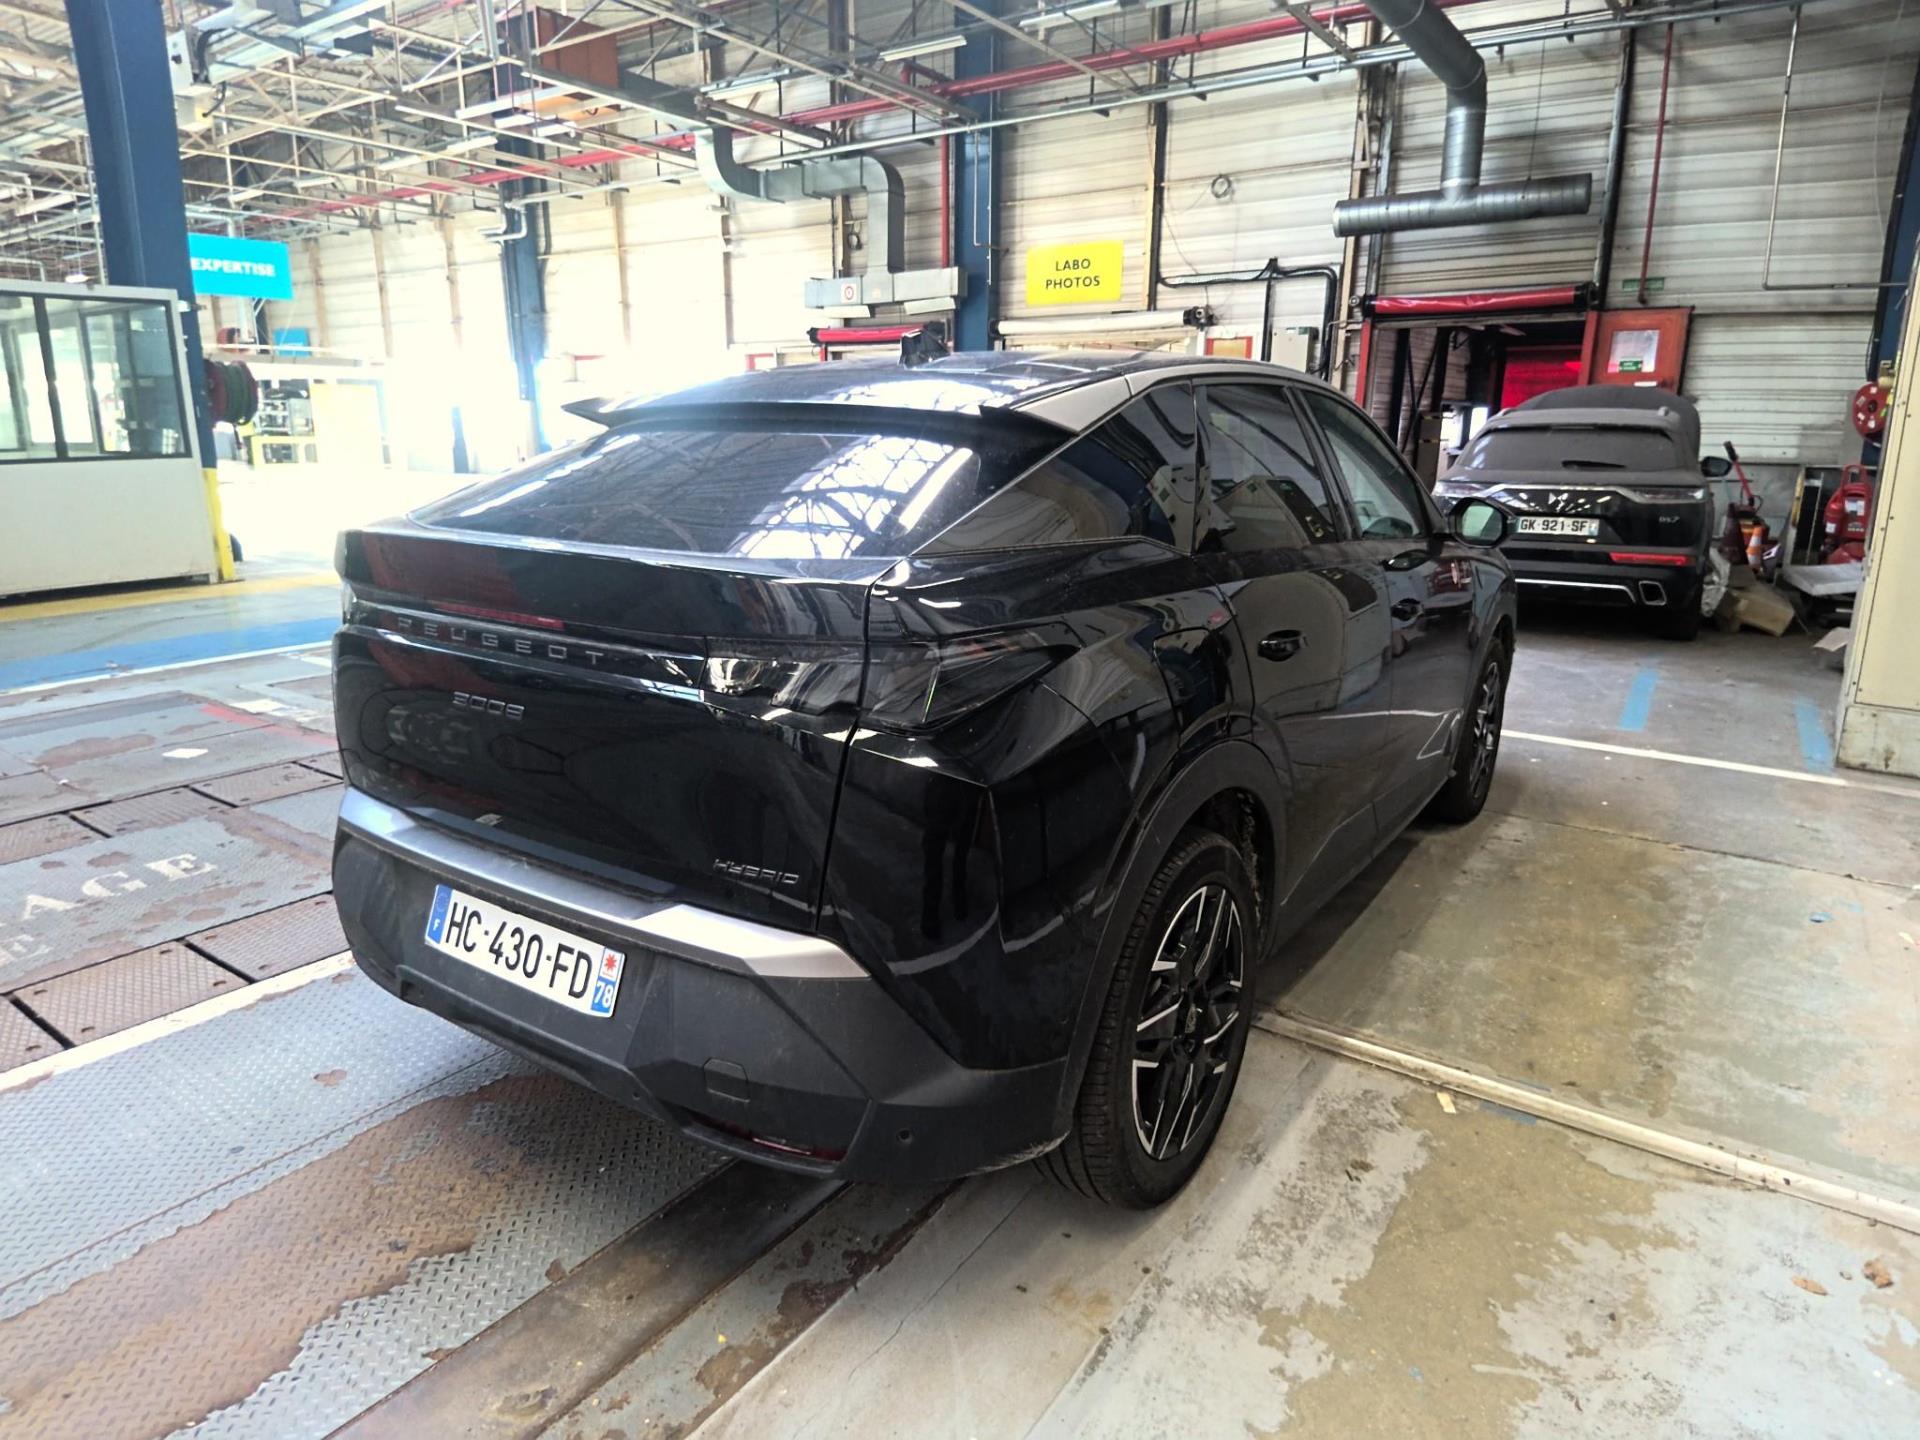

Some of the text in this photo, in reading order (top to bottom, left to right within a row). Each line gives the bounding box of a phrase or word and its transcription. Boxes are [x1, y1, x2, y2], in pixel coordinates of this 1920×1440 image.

[190, 257, 276, 277] EXPERTISE
[1055, 258, 1091, 272] LABO
[1045, 275, 1101, 290] PHOTOS
[398, 616, 604, 665] PEUGEOT
[452, 691, 525, 721] 3008
[713, 858, 800, 885] HYBRID
[433, 918, 441, 932] F
[594, 980, 615, 1009] 78
